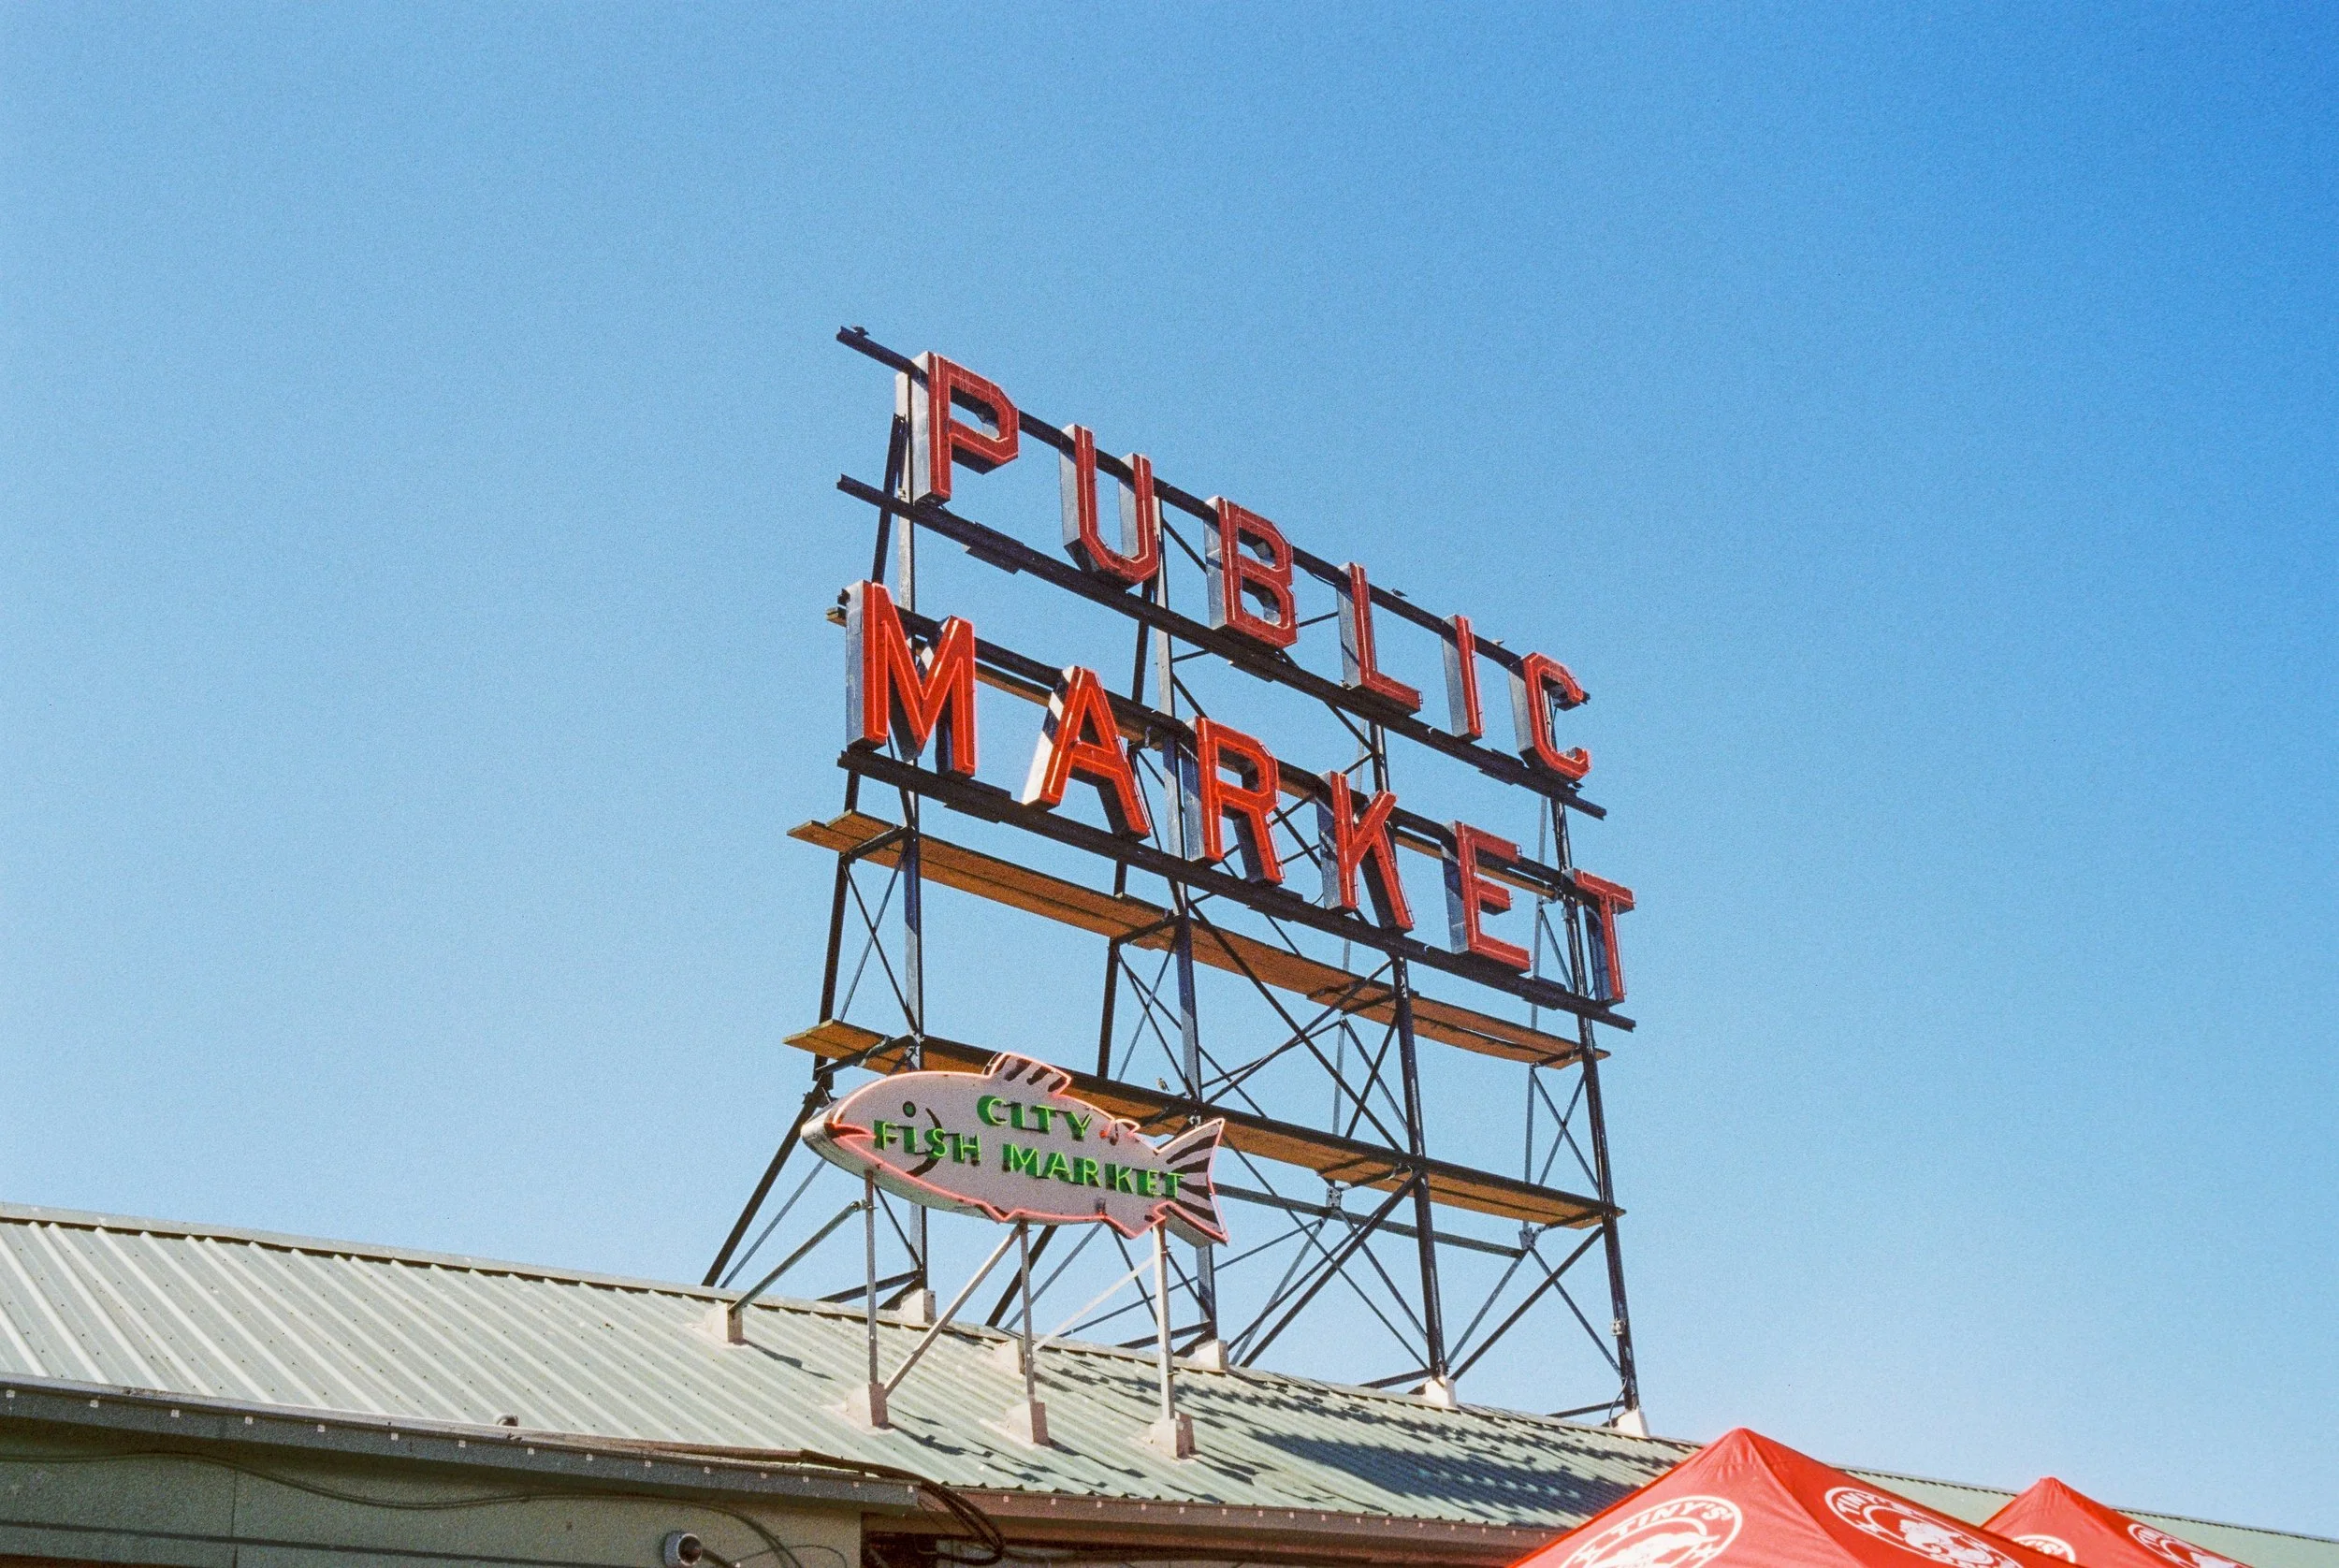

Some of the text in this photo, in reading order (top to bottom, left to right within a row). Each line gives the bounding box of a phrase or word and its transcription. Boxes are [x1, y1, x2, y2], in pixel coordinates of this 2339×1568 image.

[913, 350, 1591, 786] PUBLIC
[847, 580, 1636, 1007] MARKET
[977, 1094, 1093, 1141] CITY
[873, 1119, 1187, 1200] FISH MARKET
[1609, 1501, 1728, 1537] TINY'S
